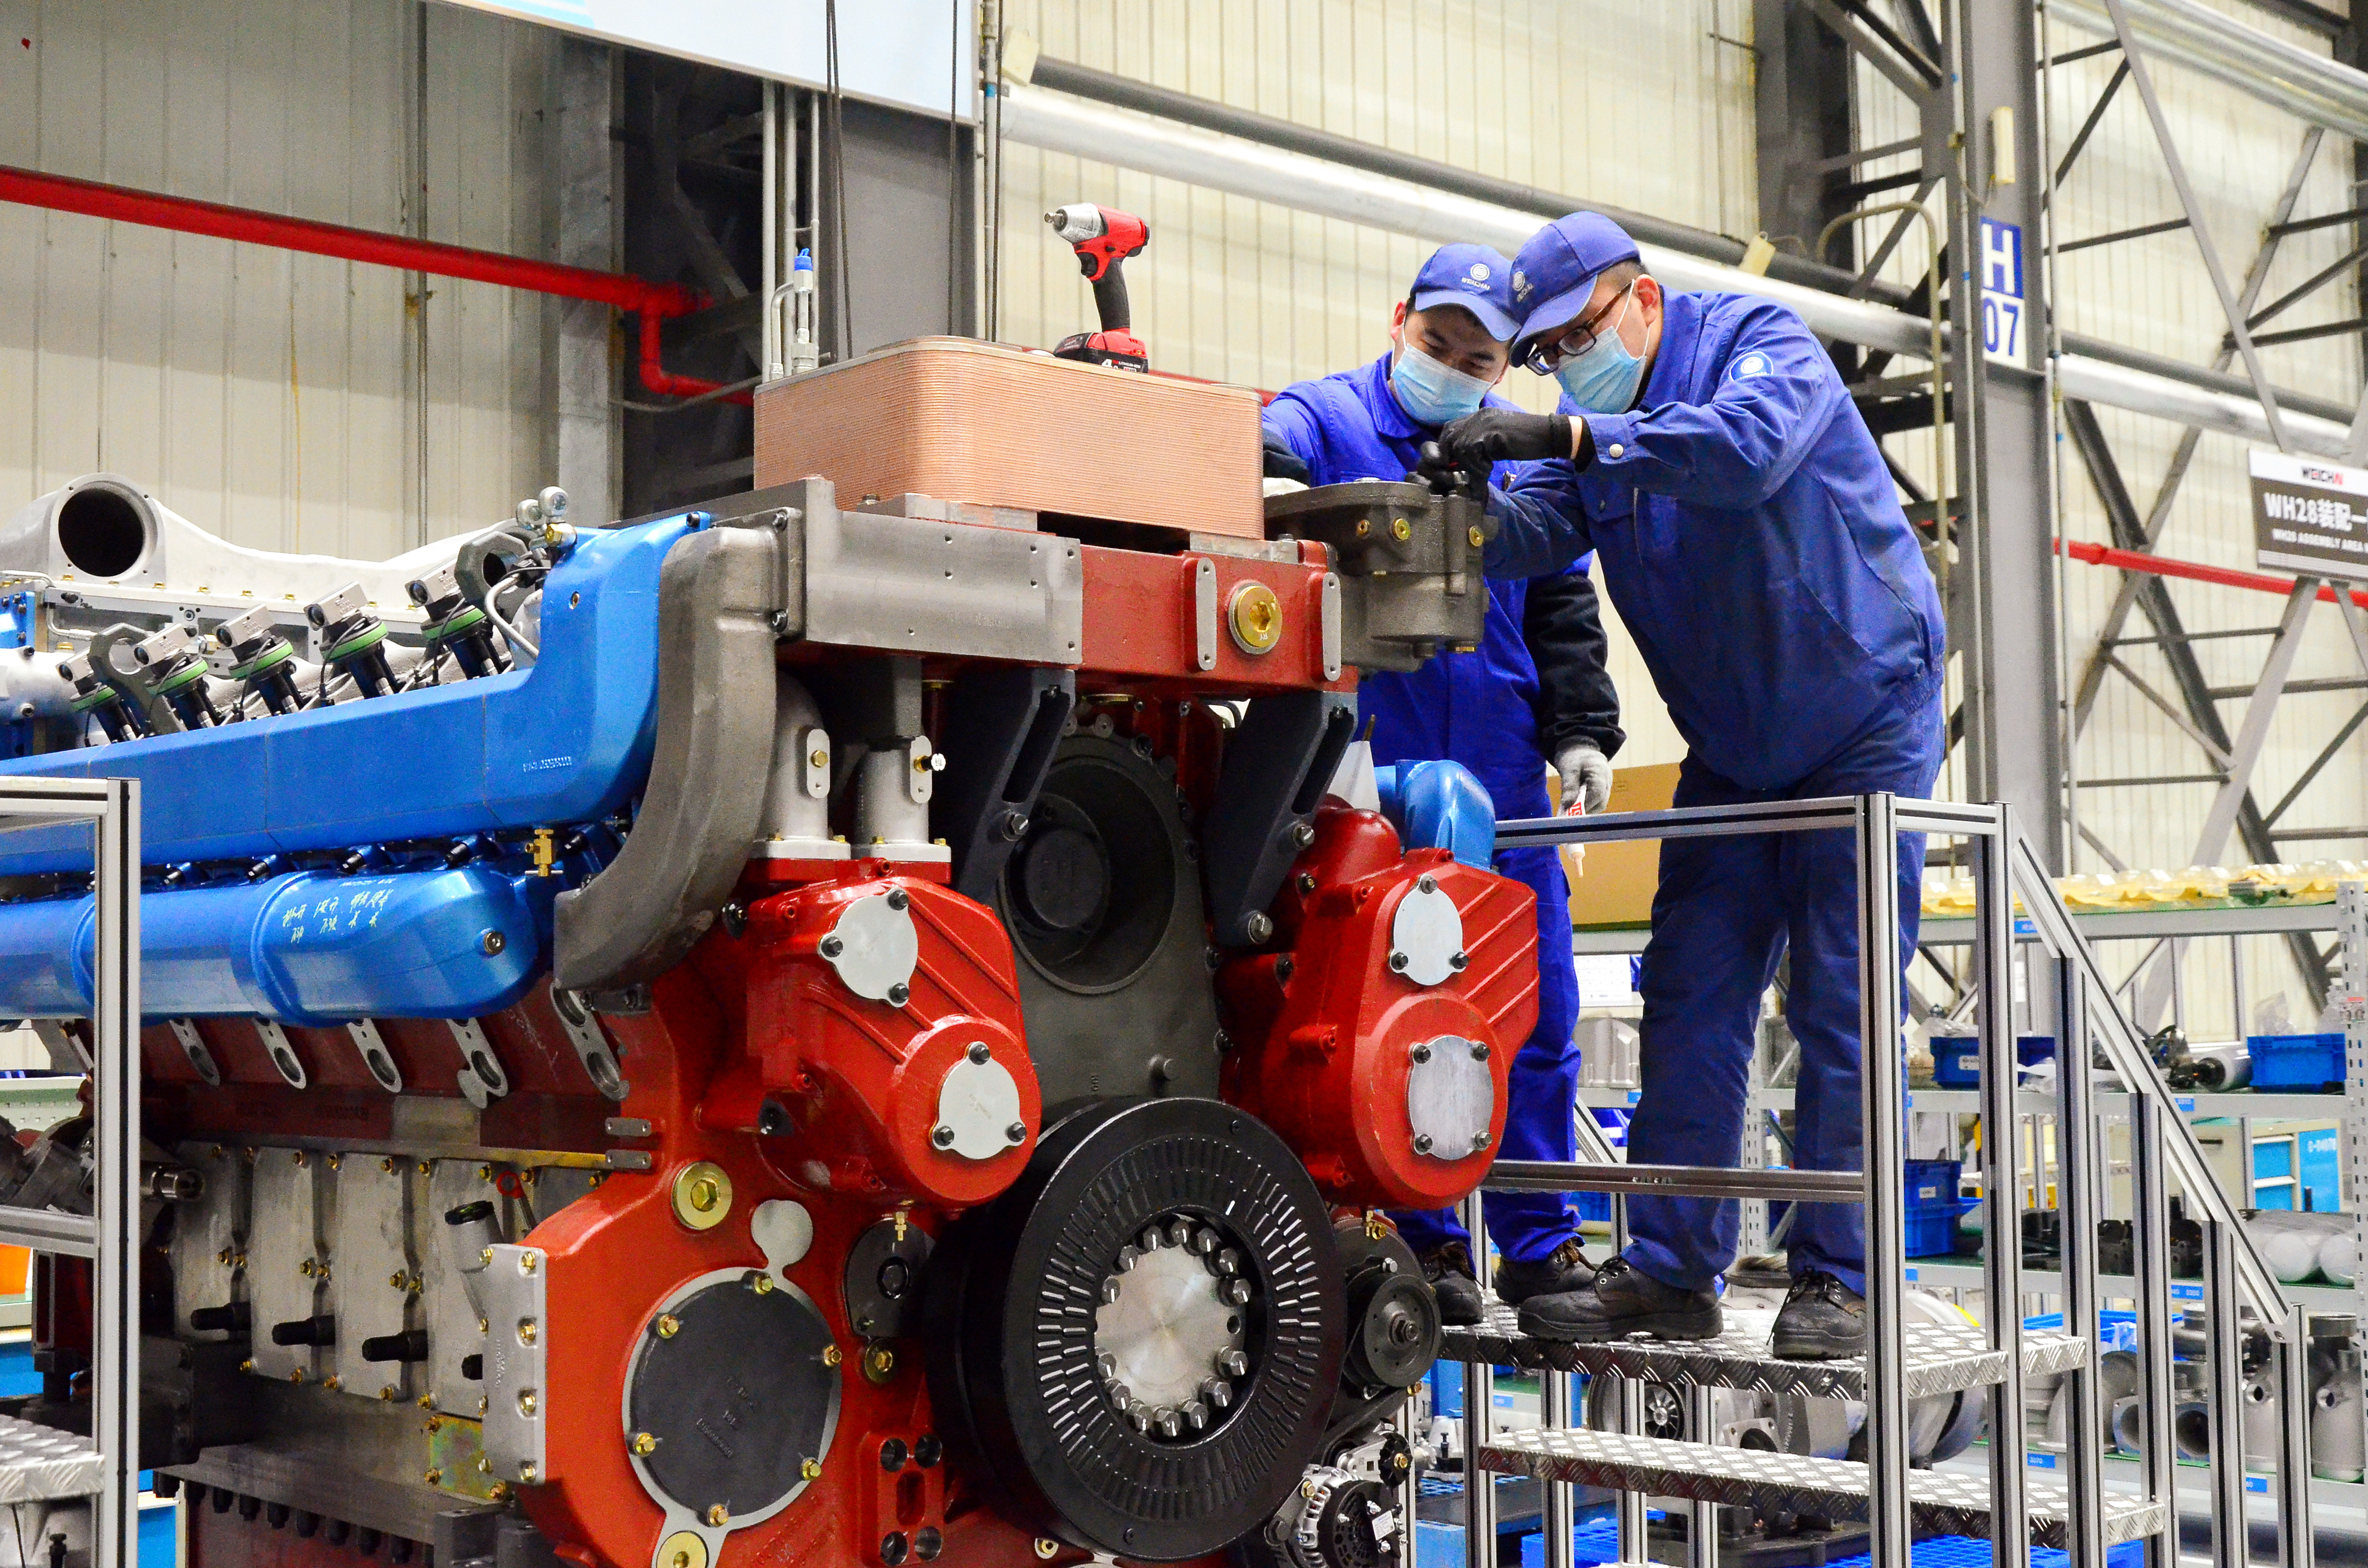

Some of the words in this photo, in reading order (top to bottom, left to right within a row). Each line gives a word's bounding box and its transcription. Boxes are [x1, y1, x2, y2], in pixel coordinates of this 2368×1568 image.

[1461, 277, 1491, 290] WEICHAI
[1981, 222, 2015, 294] H
[1984, 298, 2018, 356] 07
